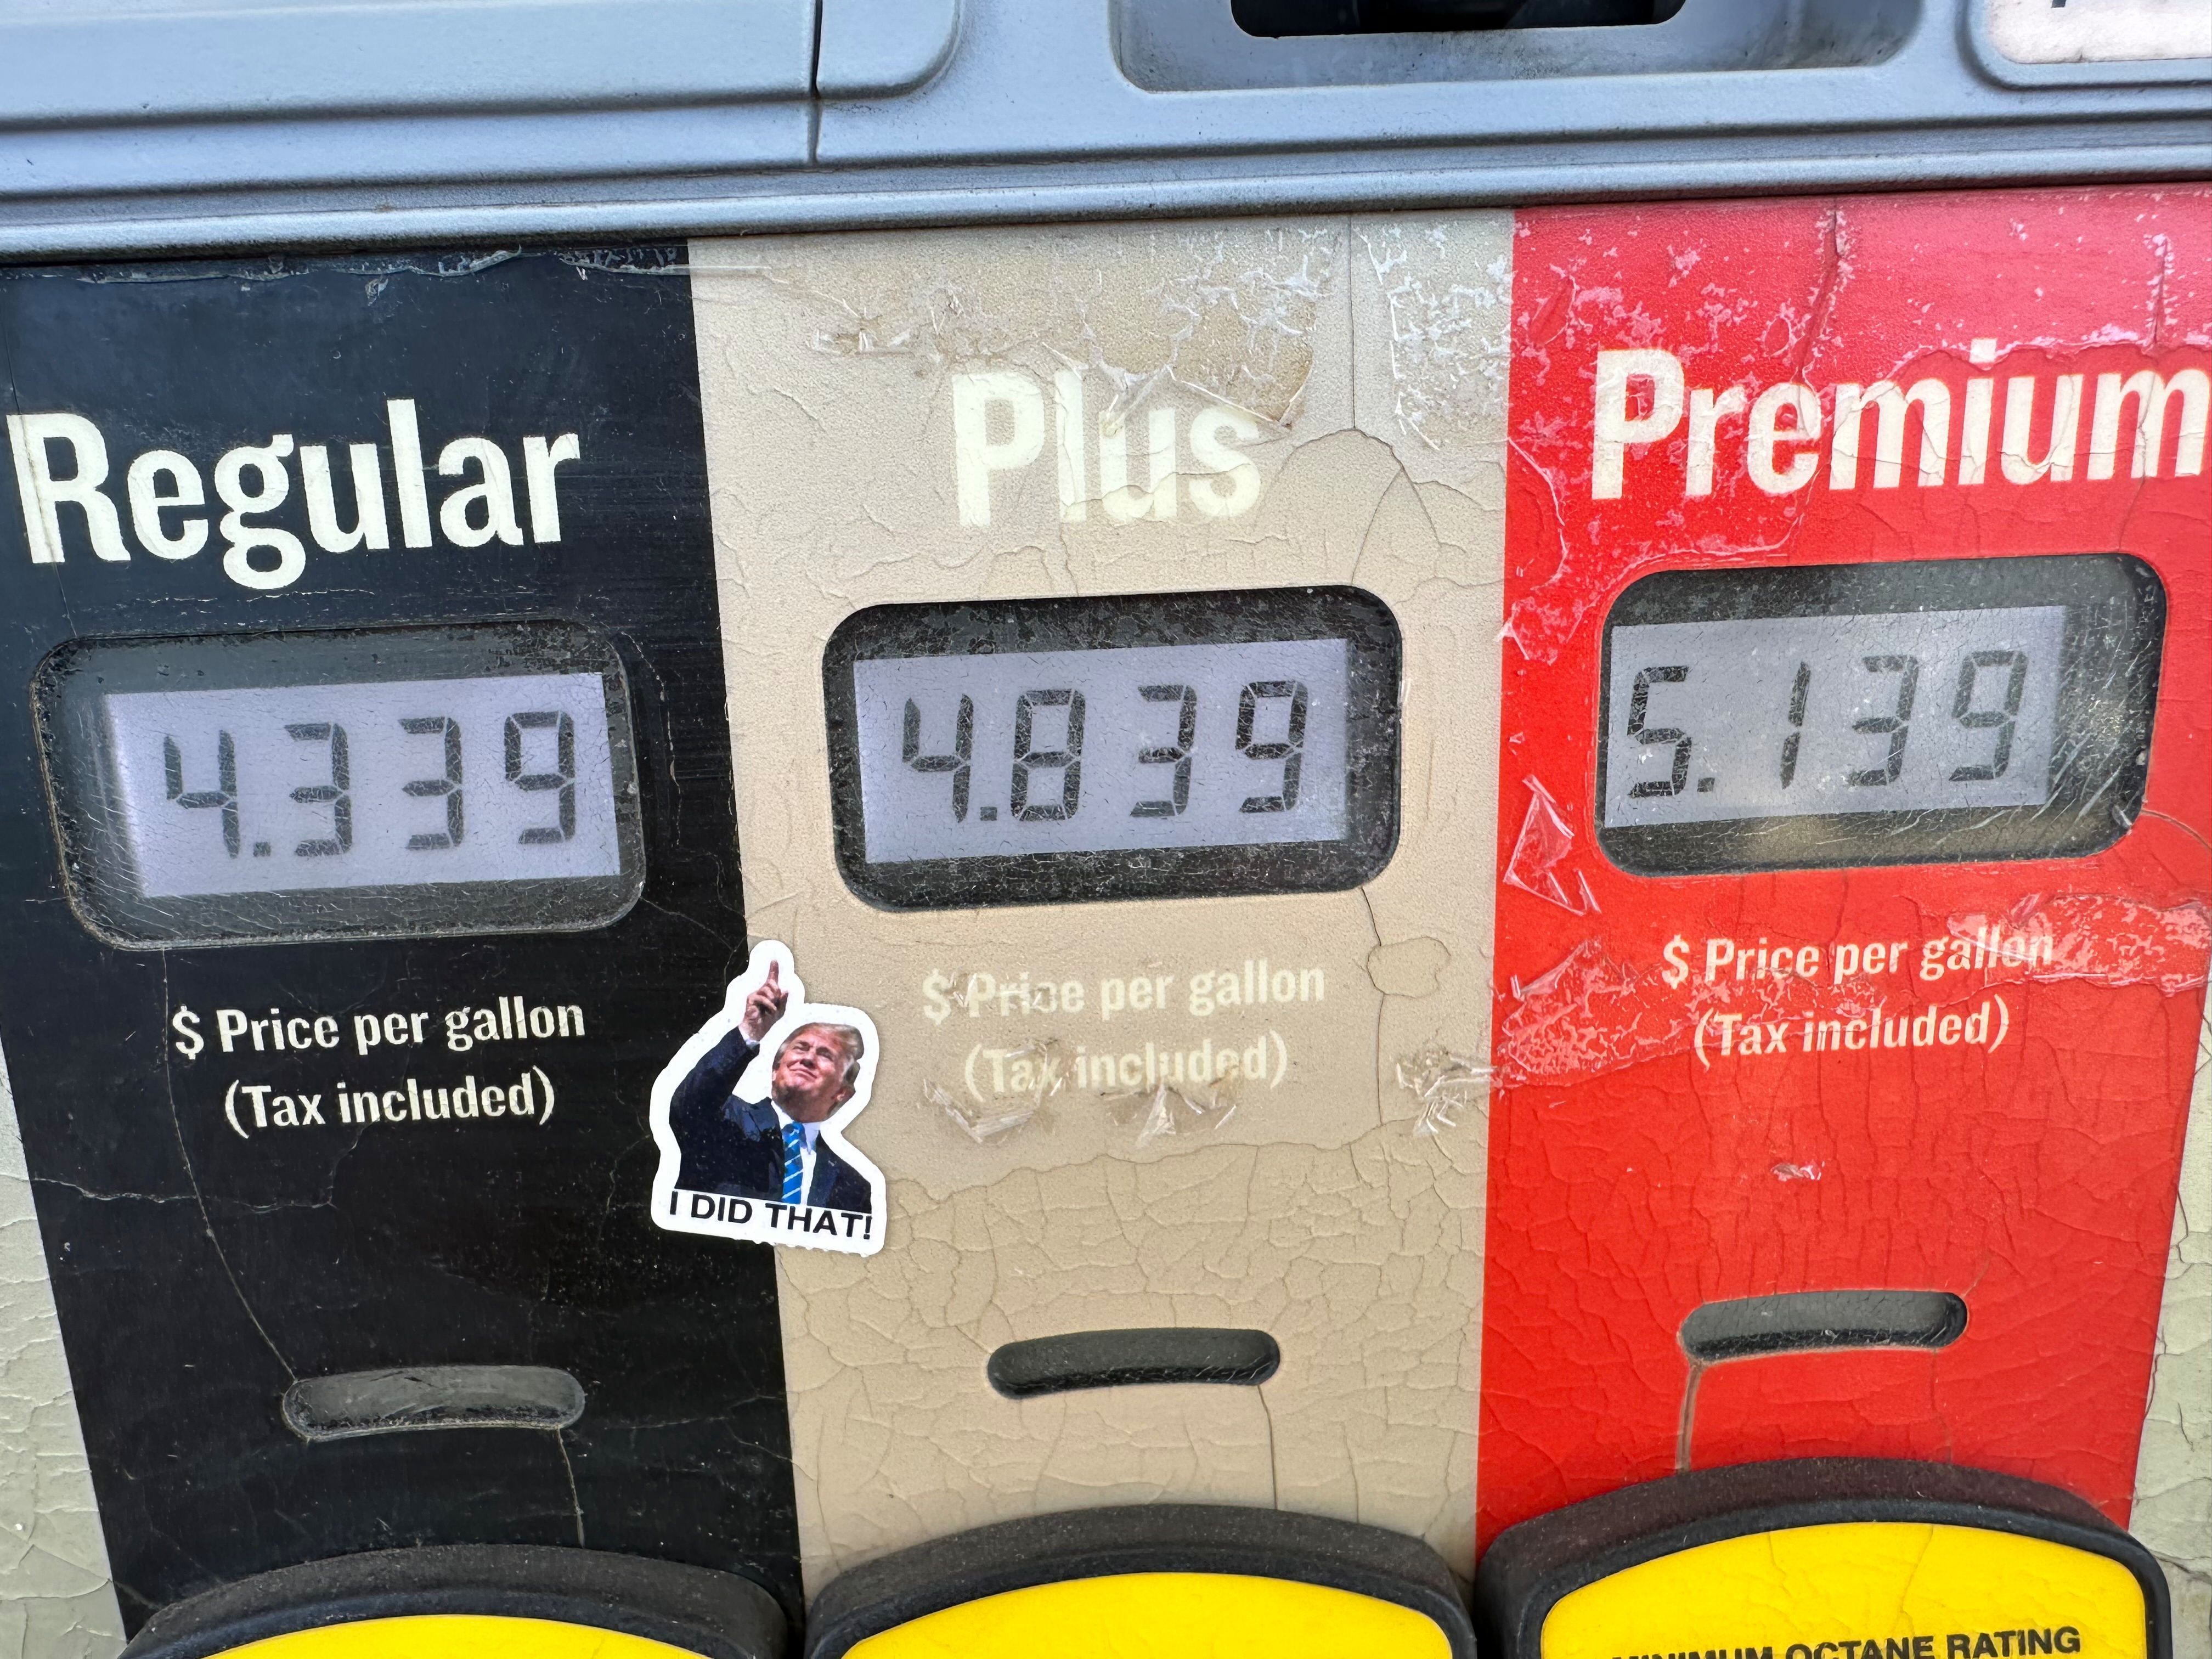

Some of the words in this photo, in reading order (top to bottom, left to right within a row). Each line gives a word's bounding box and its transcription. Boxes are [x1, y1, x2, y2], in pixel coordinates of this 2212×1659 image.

[952, 370, 1261, 527] Plus
[1592, 338, 2211, 500] Premium
[6, 399, 580, 590] Regular
[902, 680, 1308, 822] 4.839
[1626, 650, 2029, 798] 5.139
[163, 710, 575, 859] 4.339
[922, 968, 952, 1024] $
[966, 971, 1085, 1018] Price
[1101, 973, 1173, 1020] per
[1188, 958, 1325, 1017] gallon
[1662, 934, 1689, 989] $
[1706, 937, 1819, 985] Price
[1834, 939, 1908, 985] per
[1919, 926, 2053, 981] gallon
[172, 1005, 205, 1060] $
[216, 1008, 339, 1052] Price
[353, 1011, 428, 1055] per
[444, 996, 585, 1052] gallon
[1694, 1007, 1789, 1071] (Tax
[1803, 994, 2008, 1053] included)
[224, 1080, 326, 1139] (Tax
[337, 1065, 555, 1125] included)
[965, 1044, 1062, 1102] (Tax
[1076, 1030, 1288, 1093] included)
[670, 1190, 678, 1215] I
[691, 1194, 753, 1224] DID
[765, 1203, 873, 1240] THAT!
[1785, 1636, 1933, 1659] OCTANE
[1946, 1626, 2080, 1659] RATING
